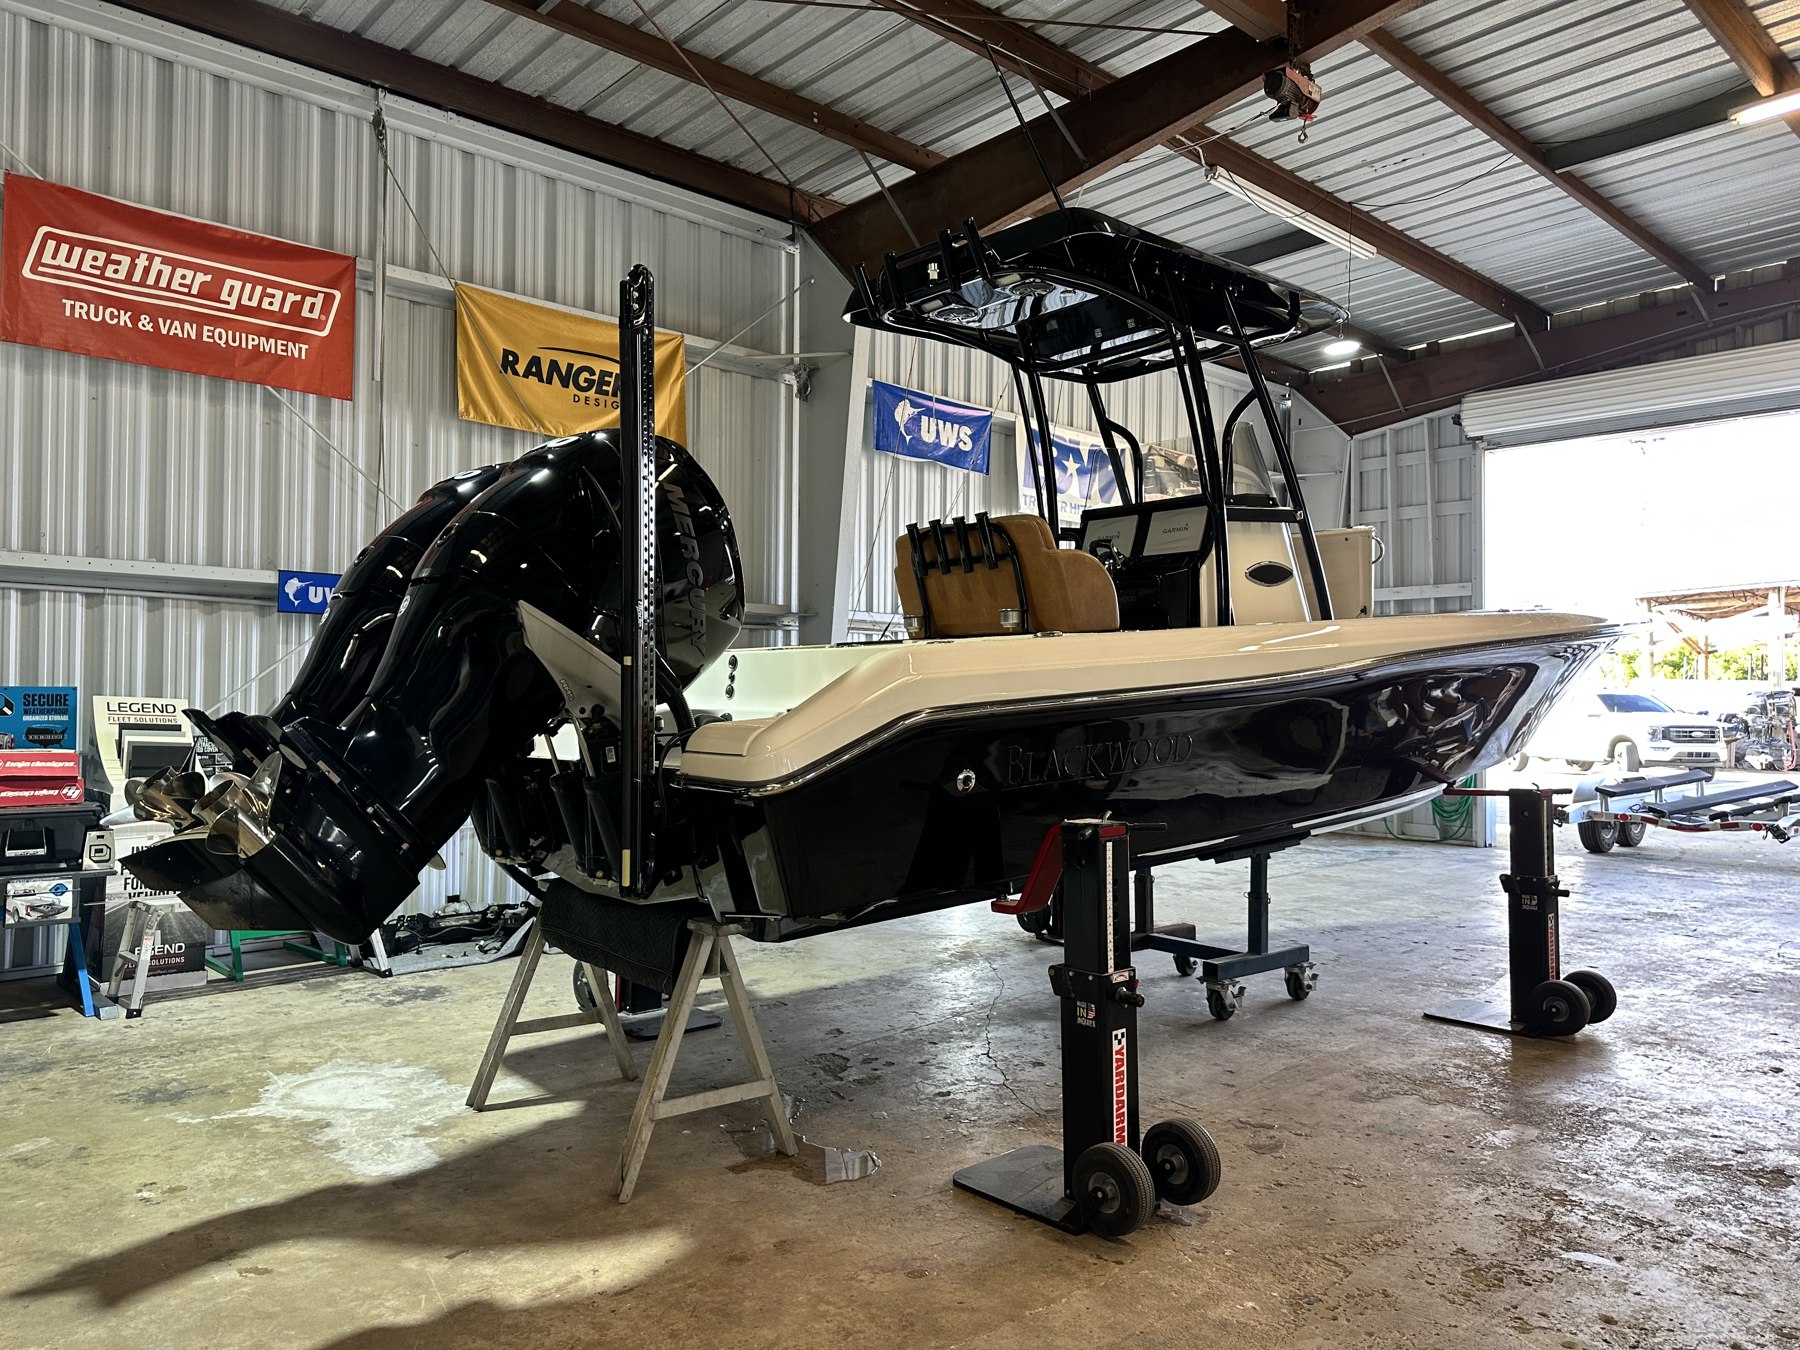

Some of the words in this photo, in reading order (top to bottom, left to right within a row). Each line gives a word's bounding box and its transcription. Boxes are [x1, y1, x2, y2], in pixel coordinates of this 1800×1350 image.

[41, 239, 212, 295] weather
[220, 278, 325, 320] guard
[62, 299, 133, 328] TRUCK
[138, 314, 154, 332] &
[158, 317, 197, 340] VAN
[202, 325, 309, 360] EQUIPMENT
[573, 394, 620, 410] DESIG
[921, 415, 973, 452] UWS
[1162, 526, 1189, 534] GARMIN
[663, 482, 706, 658] MERCURY
[23, 693, 69, 707] SECURE
[107, 702, 177, 714] LEGEND
[134, 716, 178, 724] SOLUTIONS
[1007, 734, 1193, 785] BLACKWOOD
[149, 956, 185, 966] OLUTIONS
[1076, 1006, 1087, 1018] IN
